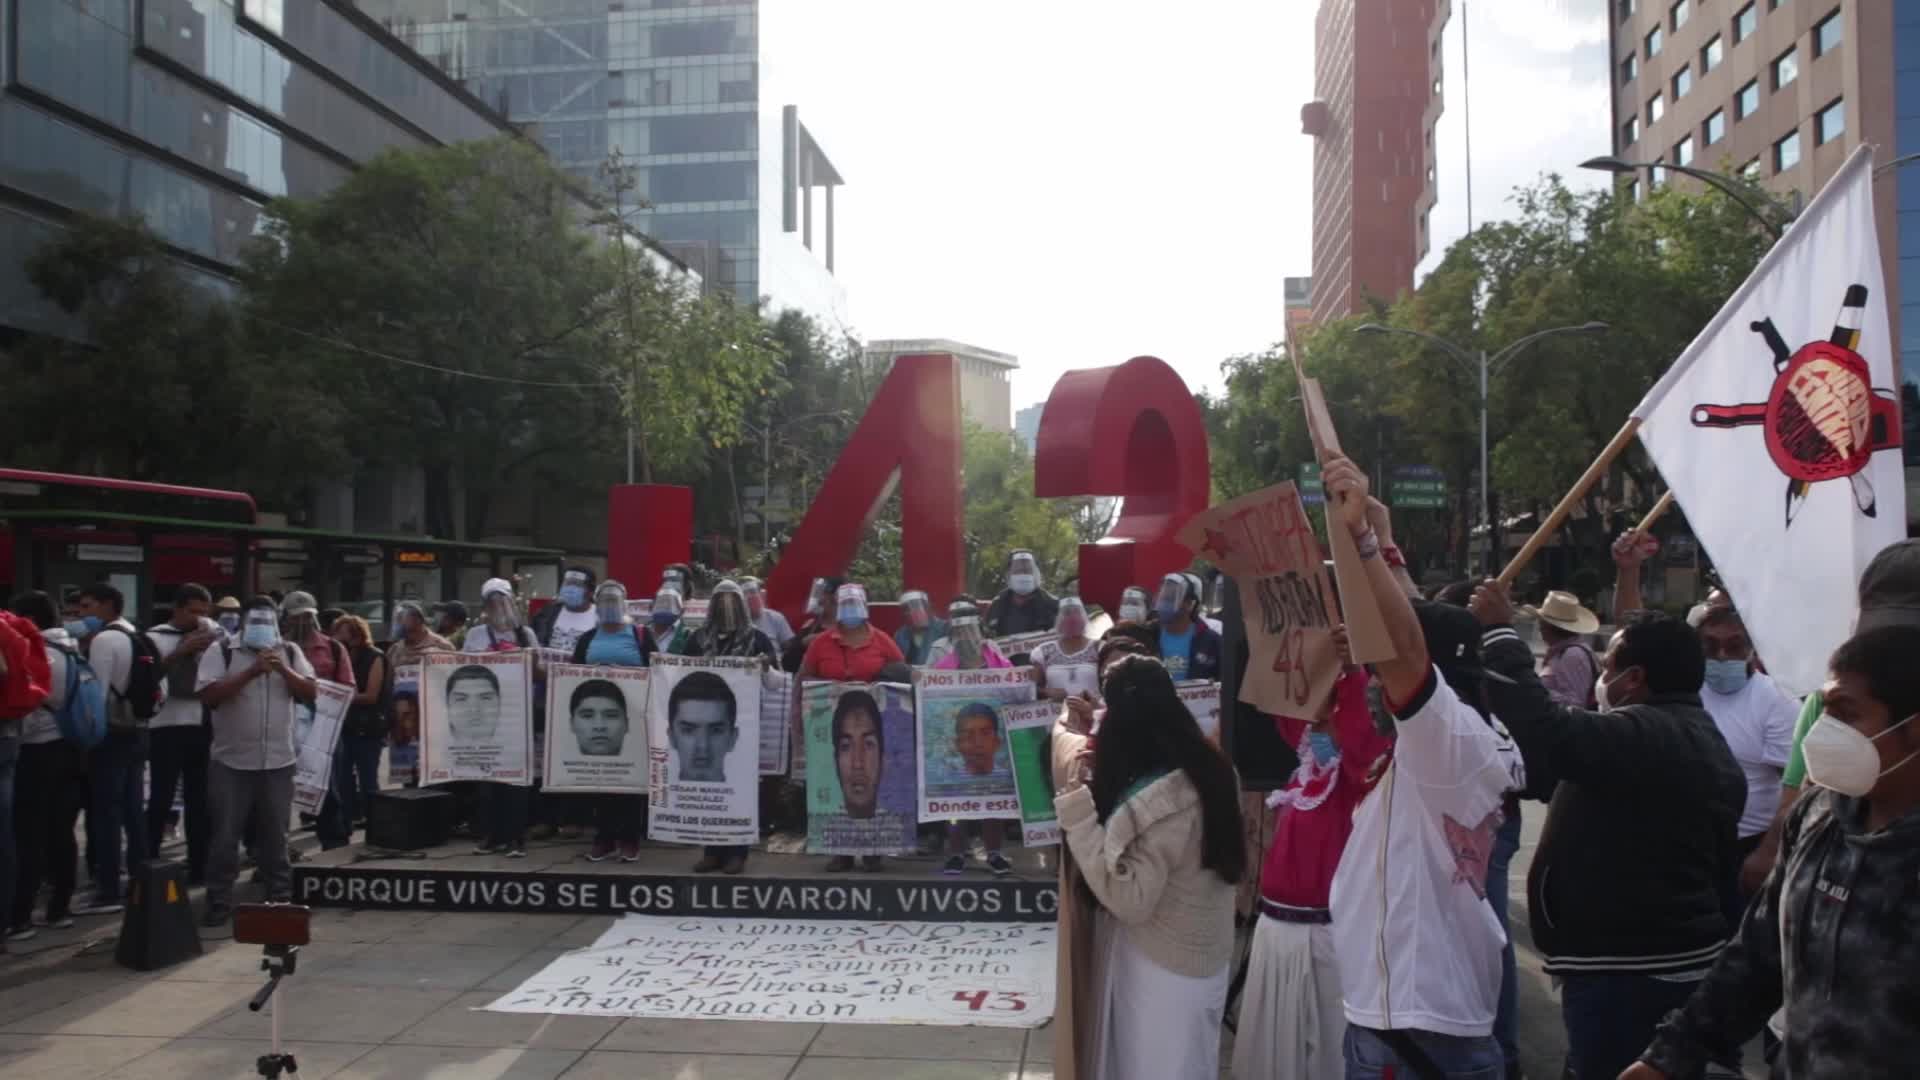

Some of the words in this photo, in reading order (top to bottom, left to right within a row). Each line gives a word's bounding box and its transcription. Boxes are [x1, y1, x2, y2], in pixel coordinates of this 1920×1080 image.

[1273, 630, 1310, 706] 43
[924, 672, 954, 688] ¡Nos
[959, 672, 1001, 685] faltan
[1035, 708, 1048, 717] se
[683, 815, 699, 825] LOS
[303, 875, 437, 903] PORQUE
[447, 879, 548, 906] VIVOS
[557, 882, 601, 907] SE
[611, 884, 678, 910] LOS
[898, 887, 1004, 913] VIVOS
[884, 923, 967, 938] NO
[880, 977, 926, 995] de
[952, 988, 1027, 1011] 43
